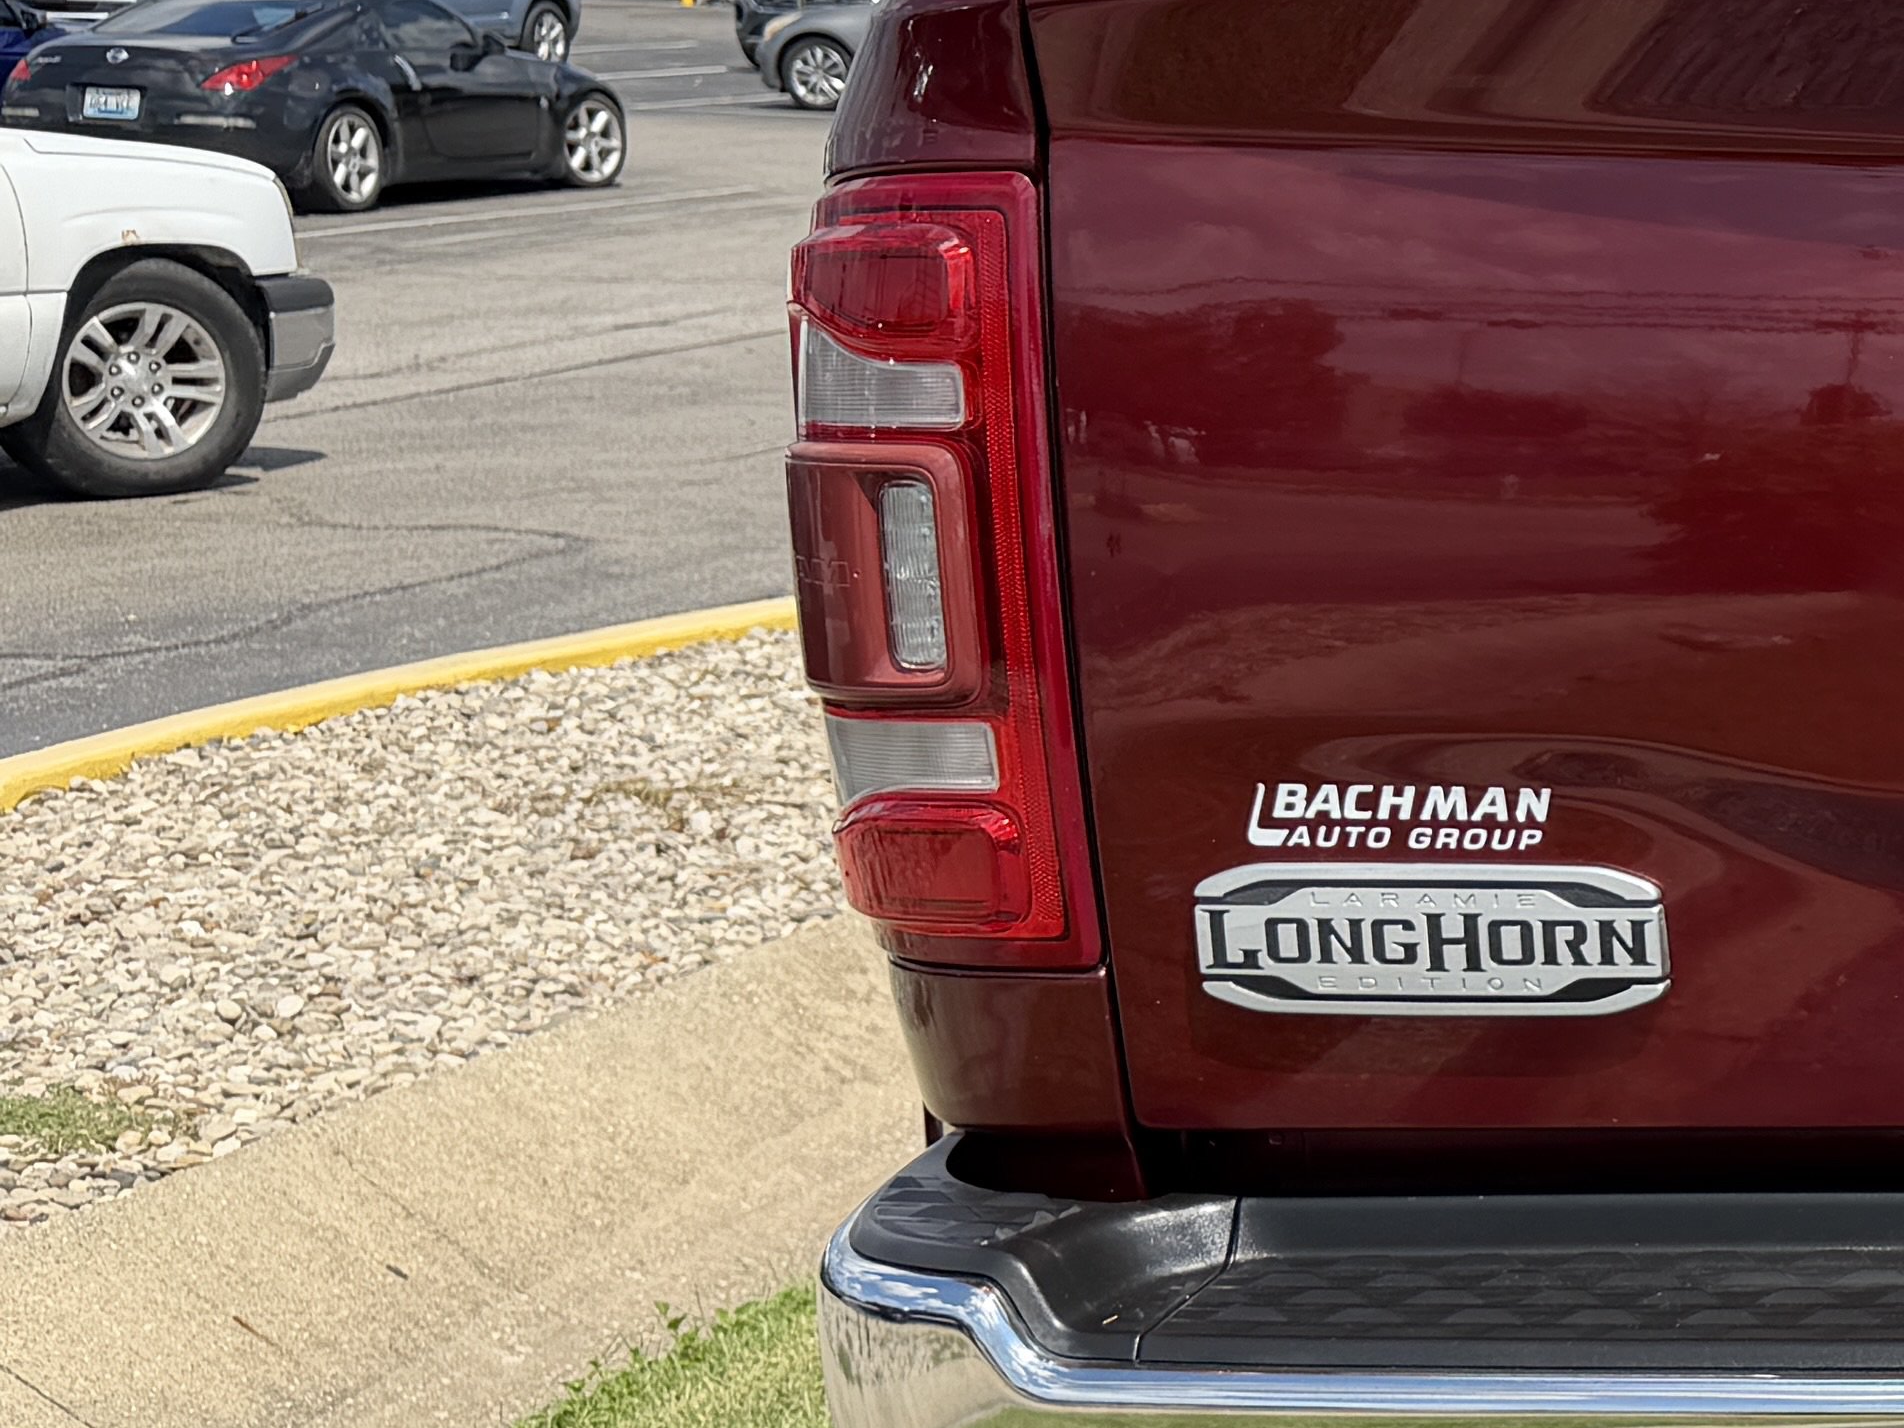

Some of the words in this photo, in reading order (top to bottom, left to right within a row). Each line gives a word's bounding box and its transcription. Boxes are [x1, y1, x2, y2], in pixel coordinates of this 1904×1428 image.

[1271, 782, 1552, 823] BACHMAN
[1286, 825, 1391, 850] AUTO
[1408, 827, 1544, 851] GROUP
[1309, 891, 1537, 909] LARAMIE
[1317, 975, 1543, 992] EDITION
